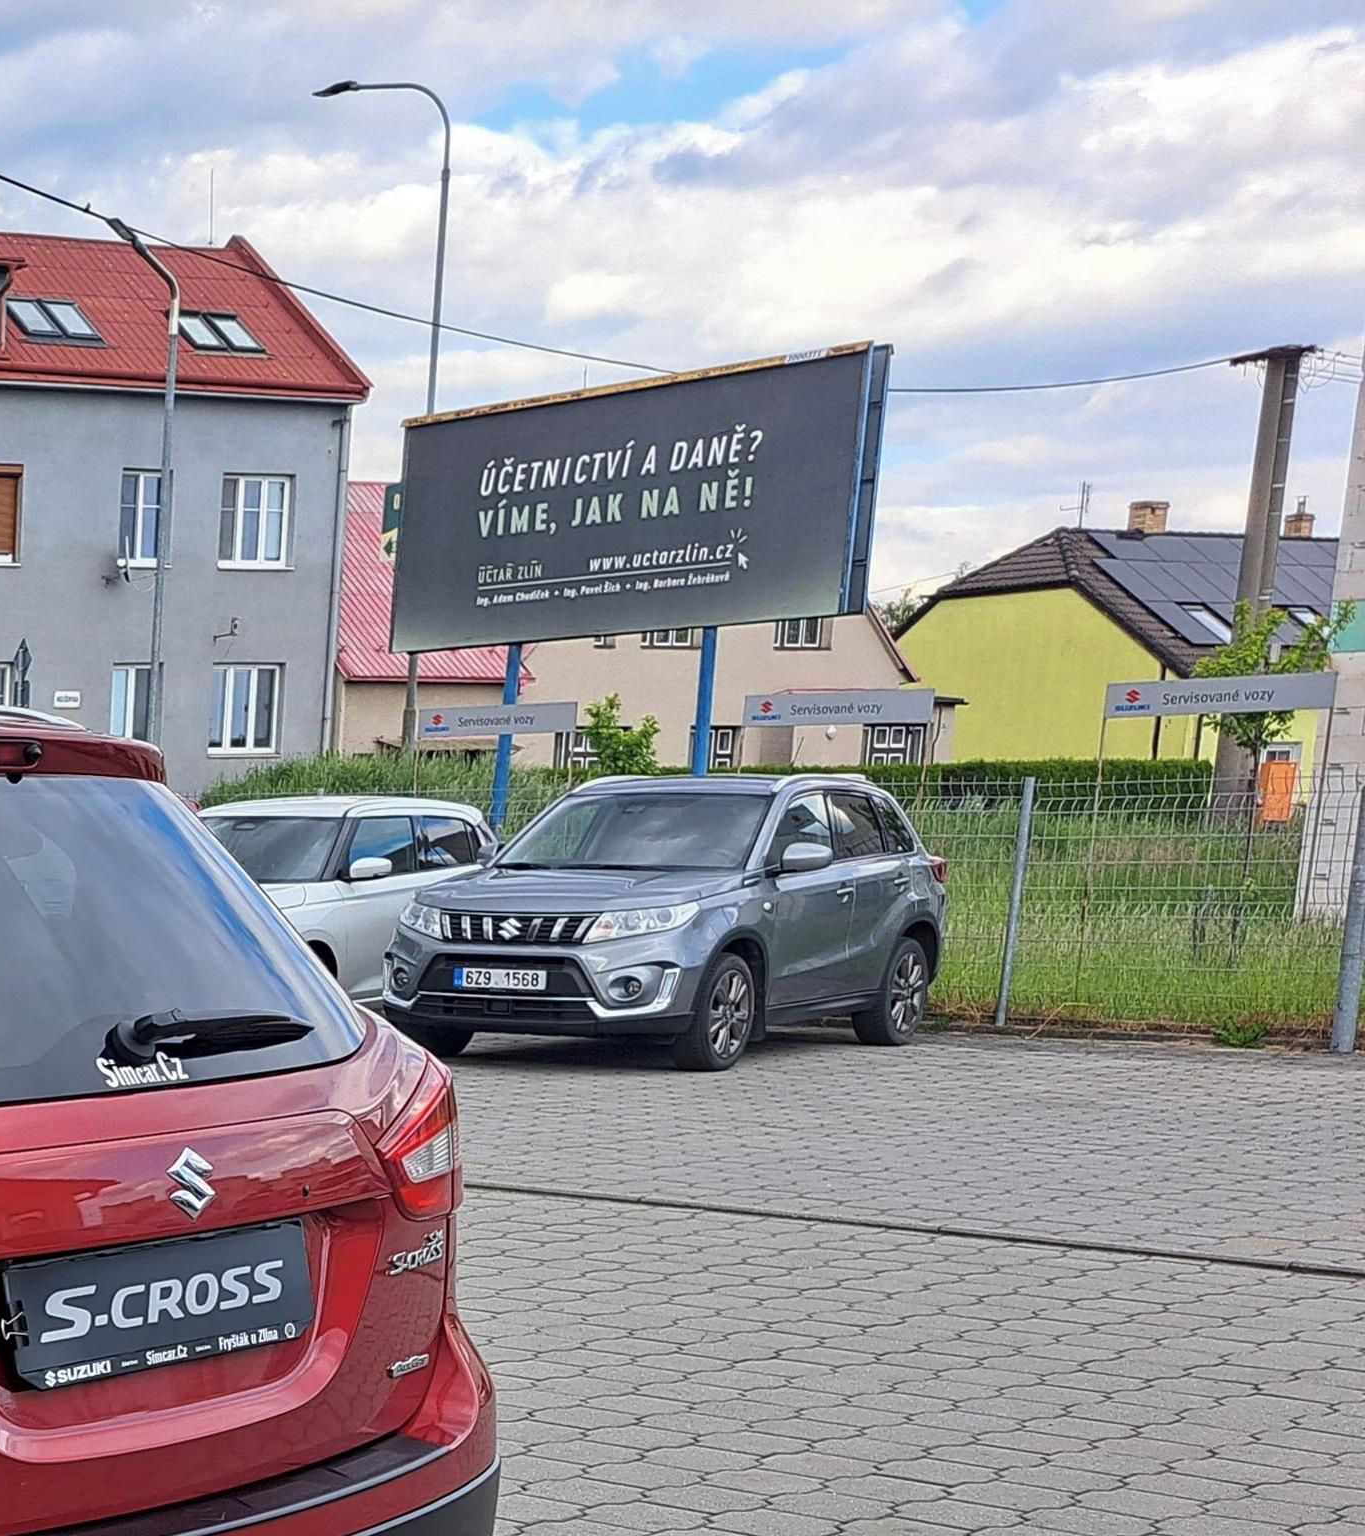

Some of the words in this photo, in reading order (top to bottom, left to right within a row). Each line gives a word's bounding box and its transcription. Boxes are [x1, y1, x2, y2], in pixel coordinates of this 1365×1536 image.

[480, 440, 635, 496] ÚČETNICTVÍ
[640, 445, 656, 475] A
[670, 424, 763, 471] DANĚ?
[479, 499, 557, 537] VÍME,
[571, 493, 623, 527] JAK
[640, 486, 680, 519] NA
[699, 468, 753, 512] NĚ!
[589, 543, 734, 572] www.uctarzlin.cz
[790, 702, 854, 716] Servisované
[857, 703, 882, 715] vozy
[1162, 690, 1240, 706] Servisované
[1244, 689, 1275, 702] vozy
[457, 715, 511, 728] Servisované
[514, 714, 535, 726] vozy
[465, 971, 491, 985] 6Z9
[504, 972, 540, 987] 1568
[96, 1051, 189, 1088] Simcar.Cz
[40, 1260, 284, 1343] S-CROSS
[57, 1360, 112, 1384] SUZUKI
[146, 1344, 188, 1365] Simcar.Cz
[218, 1331, 250, 1351] Fryšták
[251, 1333, 257, 1344] u
